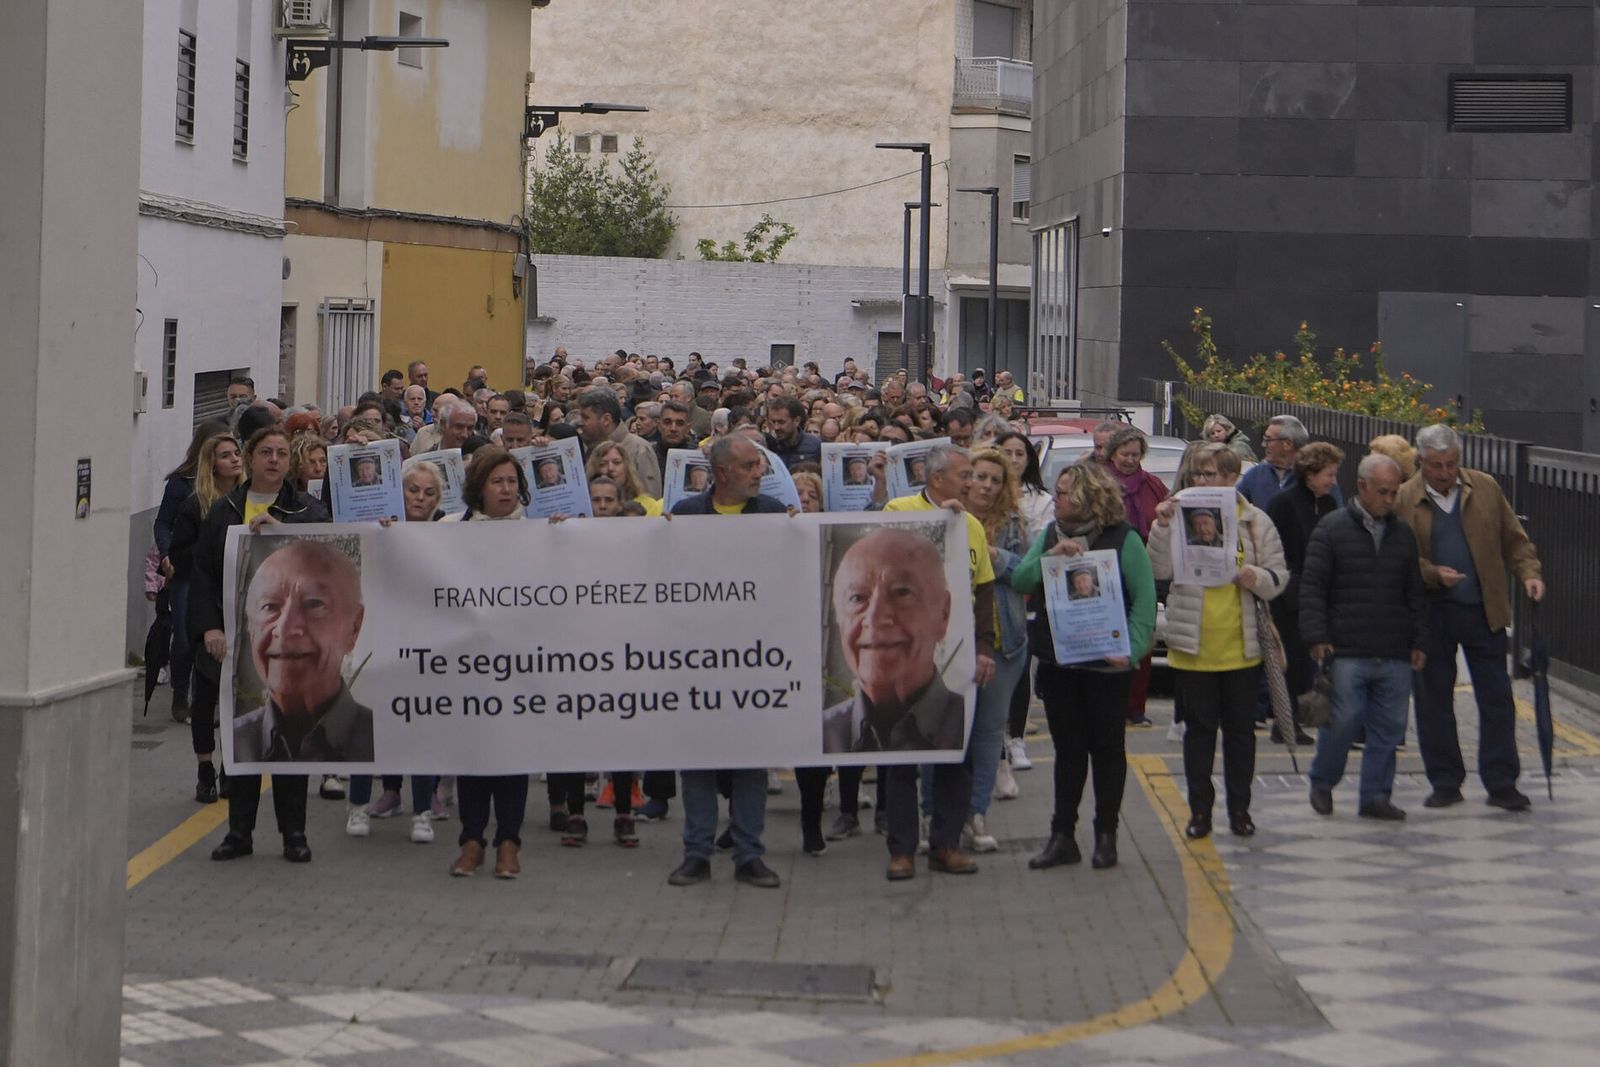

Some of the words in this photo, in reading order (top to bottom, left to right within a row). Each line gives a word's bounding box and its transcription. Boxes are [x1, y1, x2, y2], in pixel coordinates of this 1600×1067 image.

[433, 584, 568, 608] FRANCISCO
[575, 580, 648, 605] PÉREZ
[655, 581, 757, 604] BEDMAR
[398, 647, 449, 675] "Te
[457, 645, 615, 682] seguimos
[625, 640, 793, 672] buscando,
[391, 695, 453, 724] que
[462, 695, 503, 717] no
[512, 693, 547, 715] se
[555, 691, 680, 721] apague
[687, 685, 722, 711] tu
[731, 680, 802, 710] voz"
